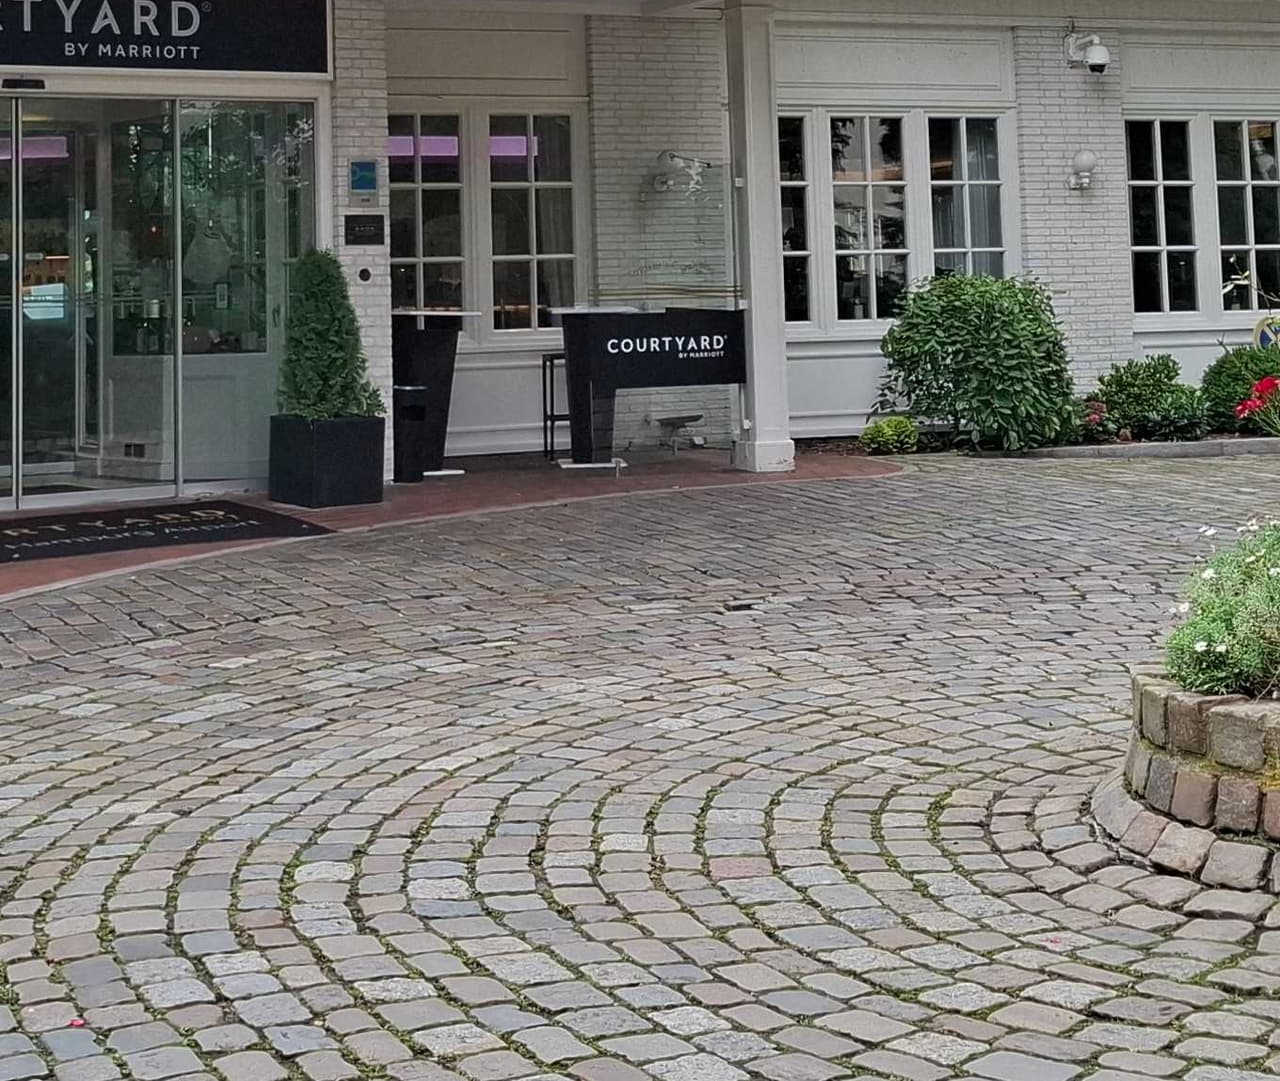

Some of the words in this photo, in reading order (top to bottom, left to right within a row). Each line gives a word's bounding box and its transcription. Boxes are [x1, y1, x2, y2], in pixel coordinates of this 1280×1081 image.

[64, 41, 88, 57] BY
[97, 43, 201, 60] MARRIOTT
[607, 335, 724, 353] COURTYARD
[689, 351, 725, 359] MARRIOTT
